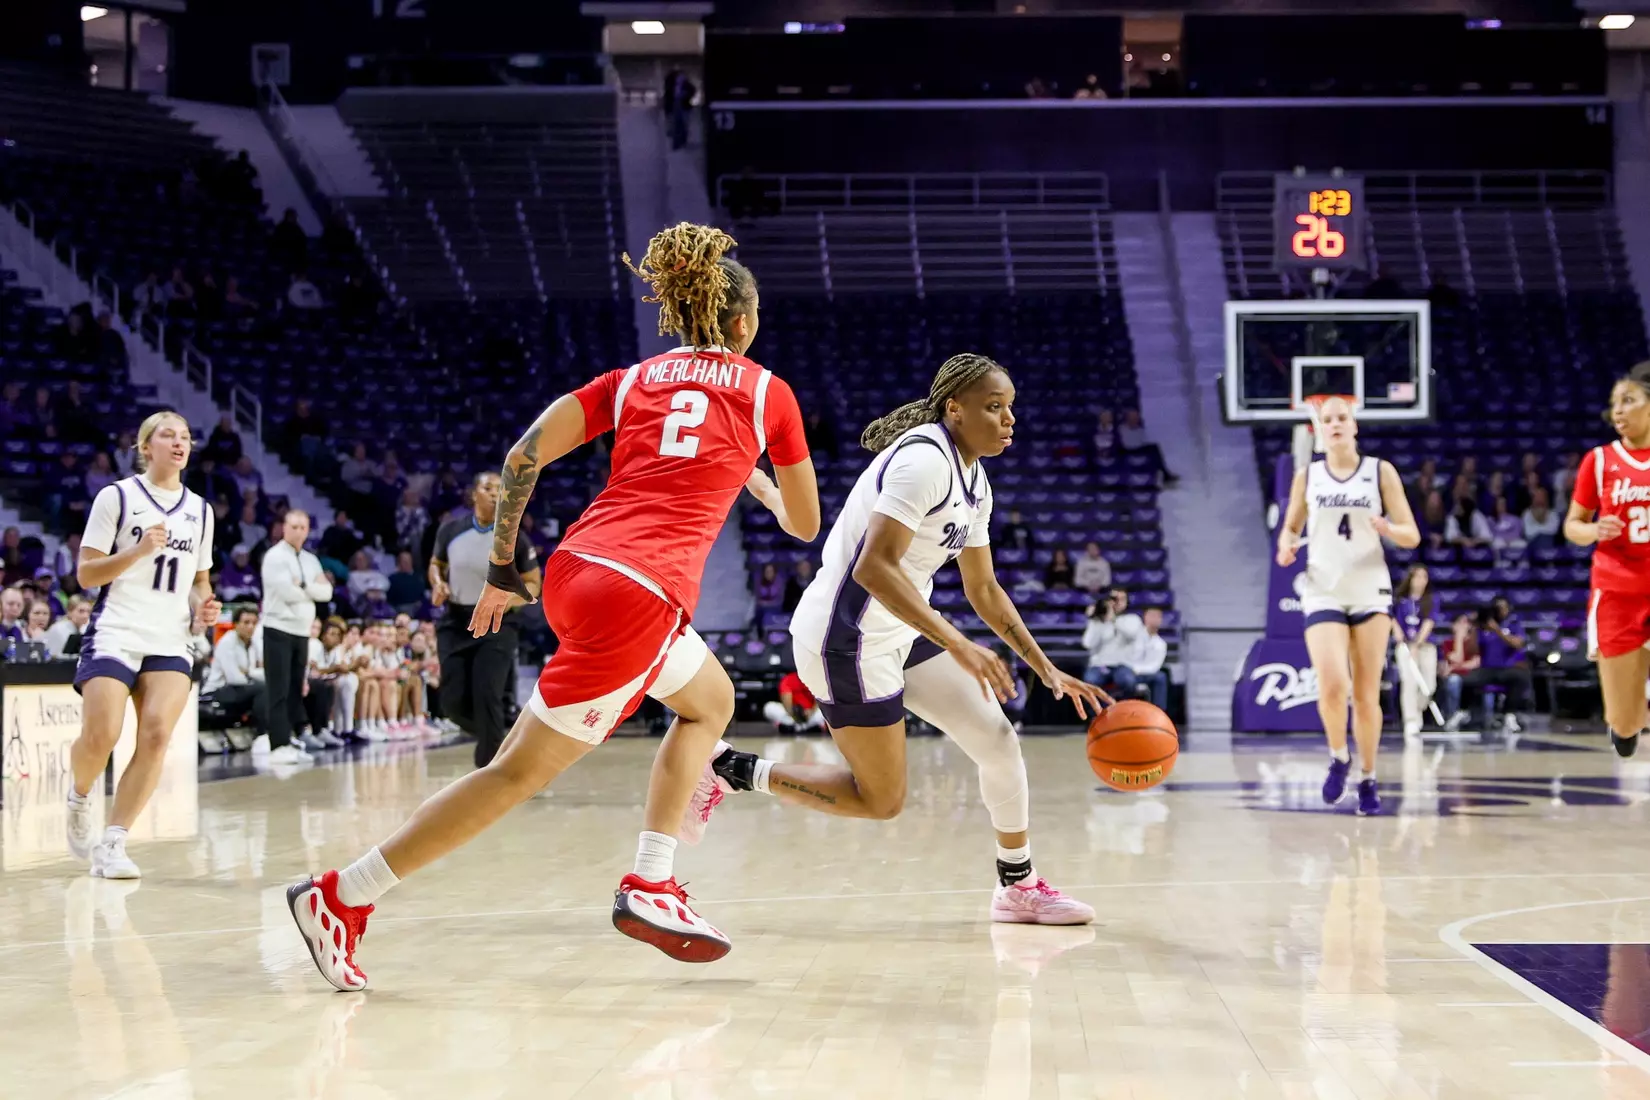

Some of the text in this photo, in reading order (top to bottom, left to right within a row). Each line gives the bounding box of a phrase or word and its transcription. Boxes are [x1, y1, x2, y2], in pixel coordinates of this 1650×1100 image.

[1292, 213, 1345, 257] 26
[644, 357, 746, 389] MERCHANT
[658, 389, 710, 459] 2
[1338, 512, 1352, 541] 4
[1627, 505, 1650, 544] 2
[152, 553, 179, 594] 11
[36, 693, 83, 727] Ascens
